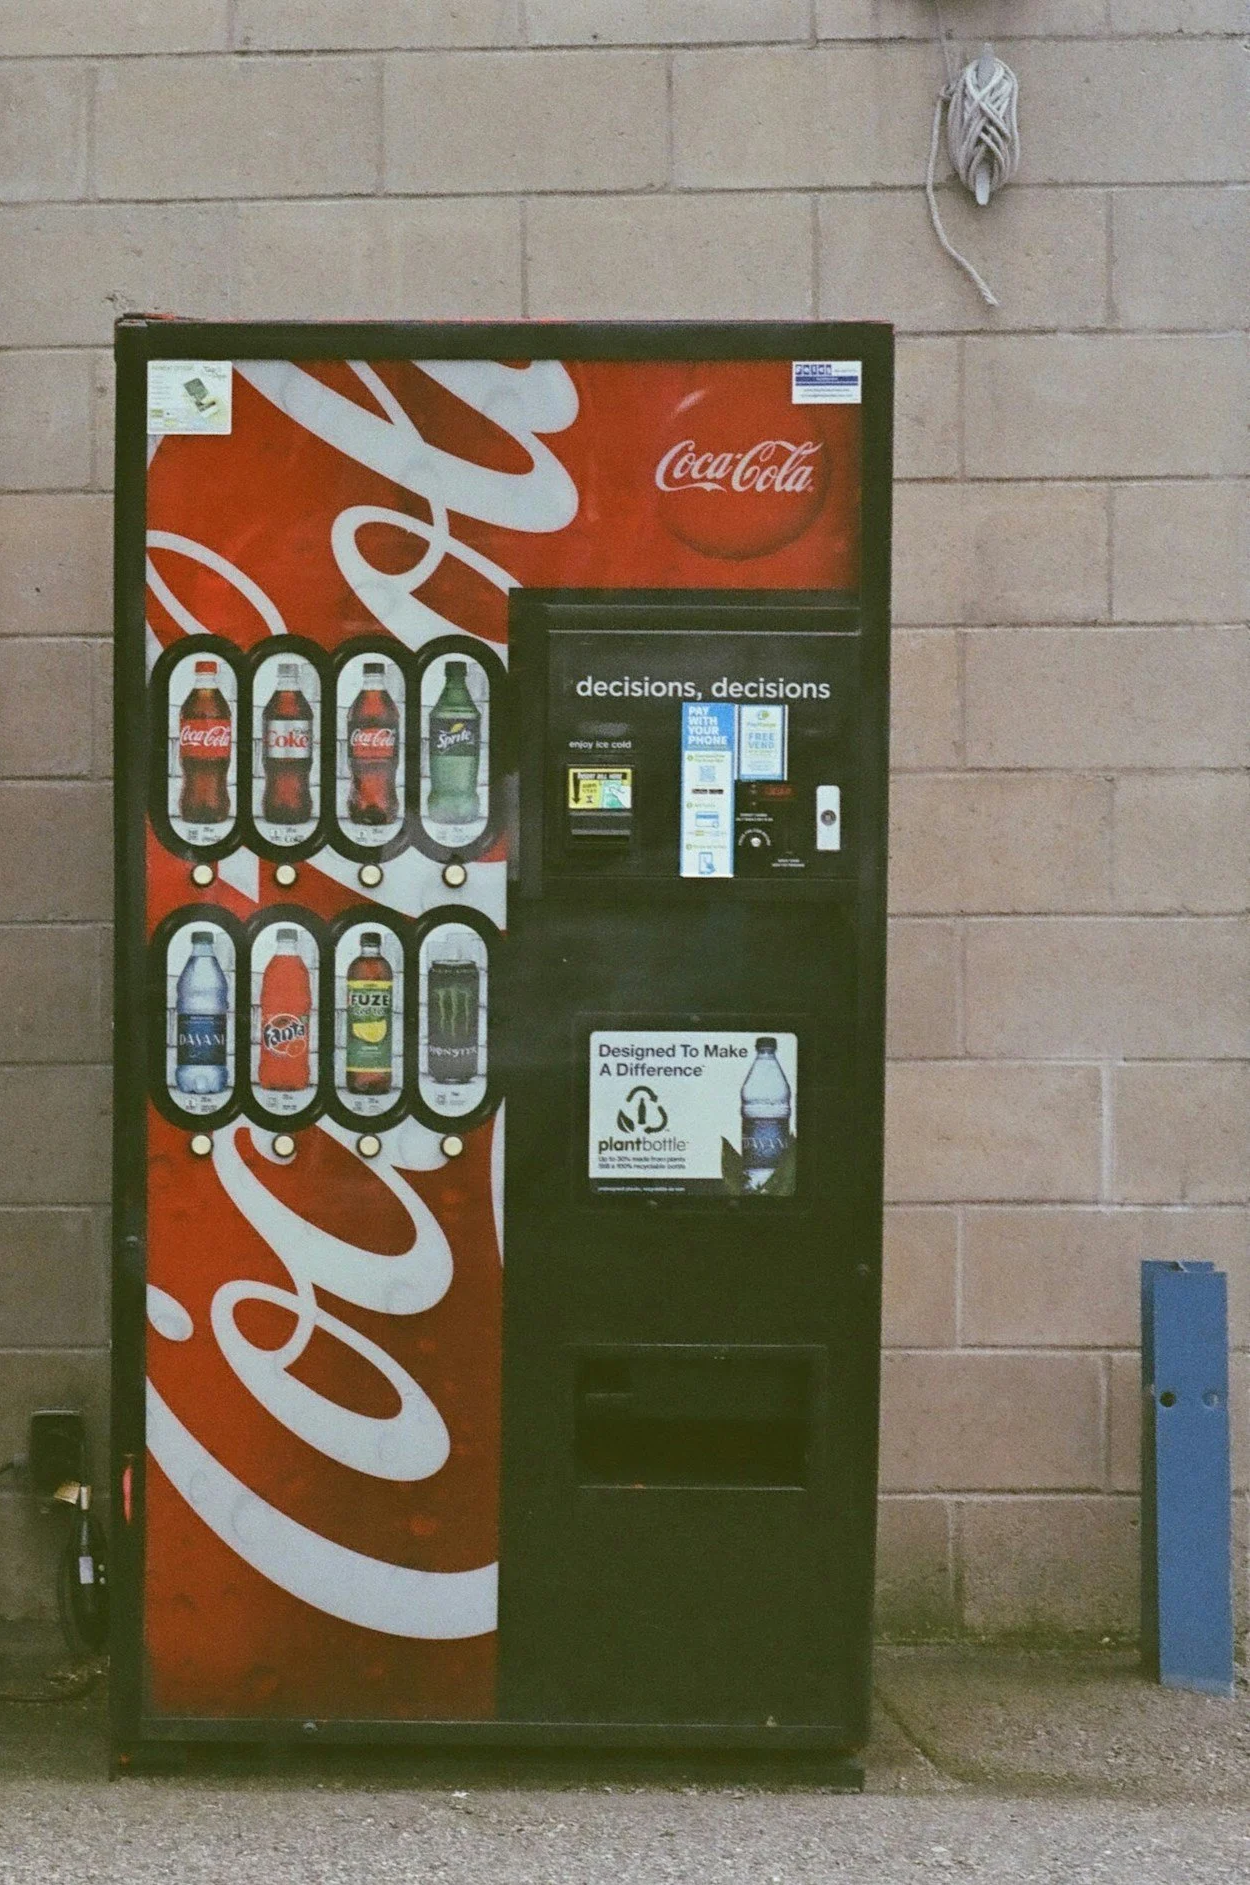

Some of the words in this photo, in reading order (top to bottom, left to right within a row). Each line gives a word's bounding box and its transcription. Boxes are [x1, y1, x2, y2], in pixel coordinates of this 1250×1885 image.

[655, 439, 823, 493] Coca-Cola
[576, 676, 703, 699] decisions,
[711, 677, 831, 699] decisions
[688, 706, 710, 716] PAY
[688, 716, 718, 726] WITH
[688, 726, 720, 736] YOUR
[749, 732, 775, 741] FREE
[264, 727, 310, 748] Coke
[437, 728, 474, 750] Sprite
[688, 735, 728, 745] PHONE
[569, 741, 594, 749] enjoy
[611, 740, 632, 749] cold
[749, 741, 775, 750] VEND
[350, 994, 390, 1006] FUZE
[598, 1044, 676, 1060] Designed
[680, 1044, 699, 1058] To
[703, 1045, 748, 1058] Make
[599, 1063, 612, 1077] A
[616, 1063, 703, 1077] Difference
[598, 1136, 687, 1155] plantbottle
